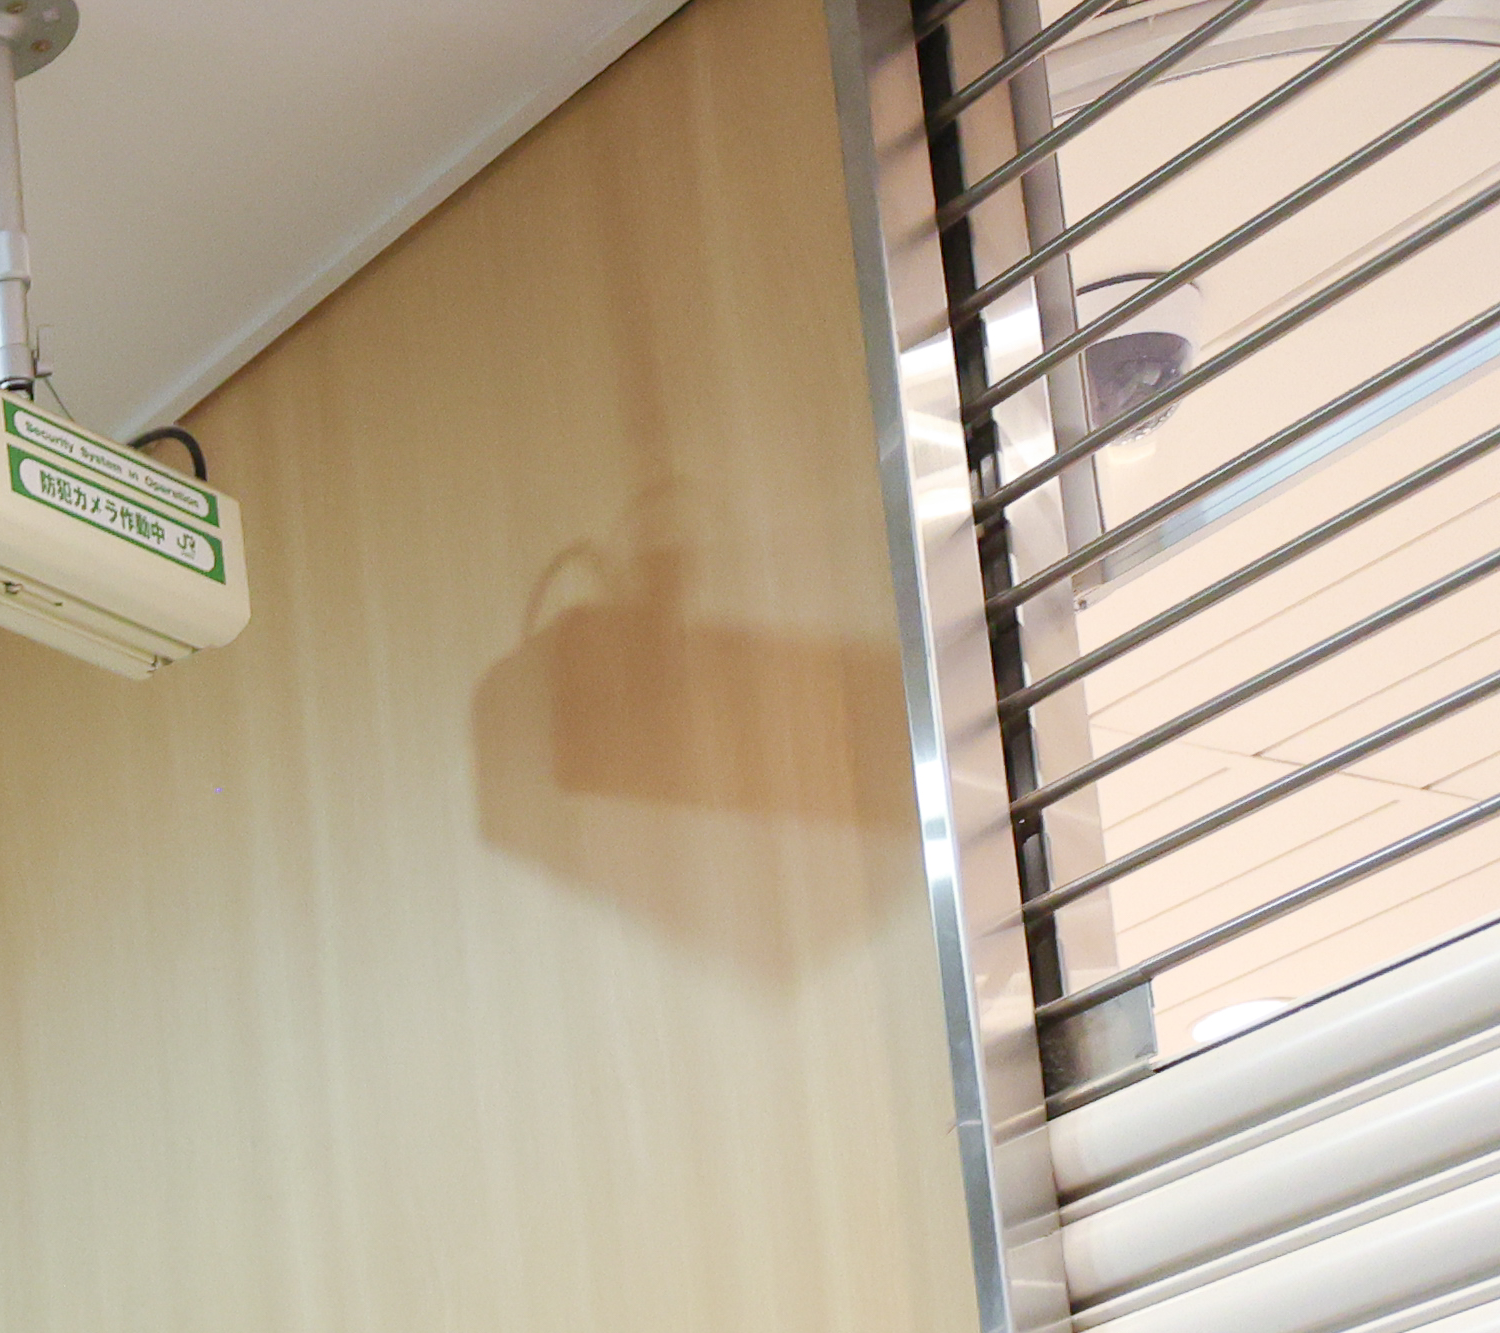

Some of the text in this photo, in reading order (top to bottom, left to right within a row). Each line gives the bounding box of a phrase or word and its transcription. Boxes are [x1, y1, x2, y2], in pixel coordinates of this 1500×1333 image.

[25, 421, 75, 453] Security
[128, 468, 139, 482] in
[39, 469, 166, 546] 防犯カメラ作動中
